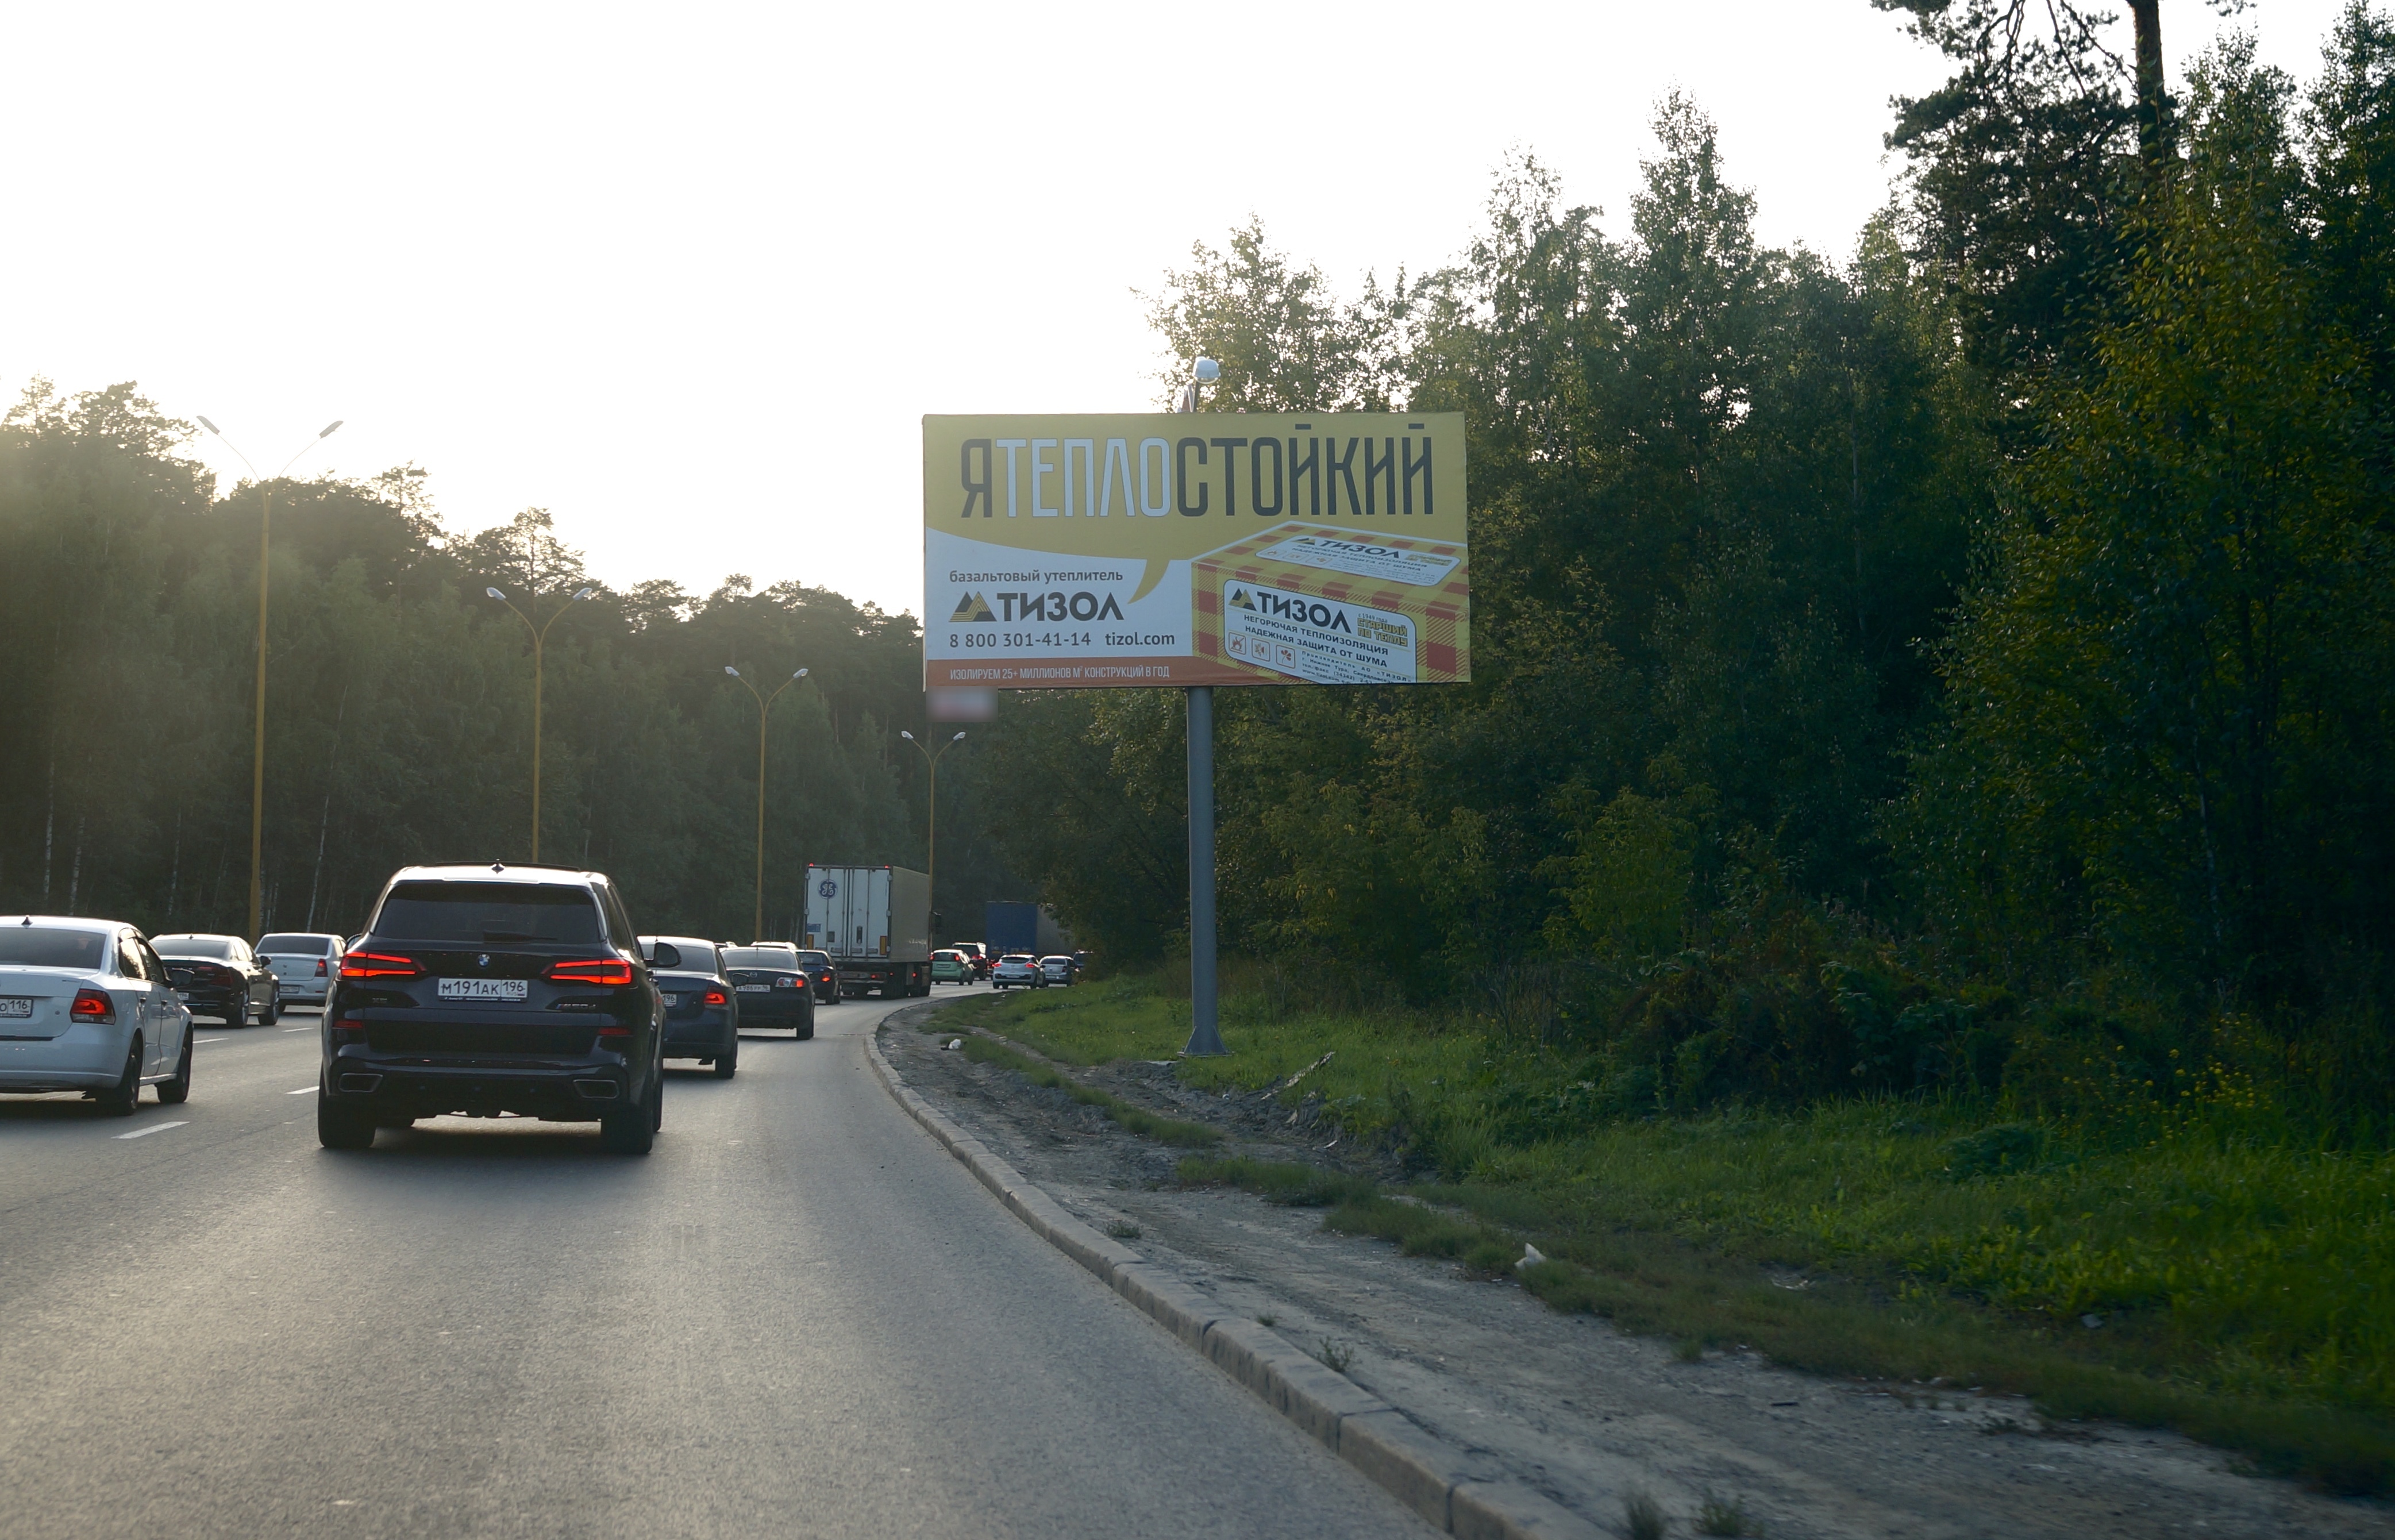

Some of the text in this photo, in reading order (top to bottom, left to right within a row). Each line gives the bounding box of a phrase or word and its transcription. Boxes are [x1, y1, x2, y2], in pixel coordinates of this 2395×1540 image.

[961, 423, 1434, 518] ЯТЕПЛОСТОЙКИЙ
[1320, 540, 1399, 559] ТИЗОЛ
[949, 569, 1123, 584] базальтовый утеплитель
[996, 591, 1125, 622] ТИЗОЛ
[1257, 591, 1352, 634] ТИЗОЛ
[1243, 614, 1389, 656] НЕГОРЮЧАЯ ТЕПЛОИЗОЛЯЦИЯ
[1357, 617, 1408, 637] СТАРШИЙ
[1357, 627, 1408, 647] ПО ТЕПЛУ
[949, 631, 1175, 648] 8 800 301-41-14 tizol.com
[1245, 625, 1388, 668] НАДЕЖНАЯ ЗАЩИТА ОТ ШУМА
[949, 667, 1001, 680] ИЗОЛИРУЕМ
[1002, 667, 1019, 680] 25+
[1019, 667, 1072, 679] МИЛЛИОНОВ
[1084, 664, 1145, 679] КОНСТРУКЦИЙ
[1145, 666, 1152, 678] В
[1152, 665, 1170, 679] ГОД
[502, 981, 525, 992] 196
